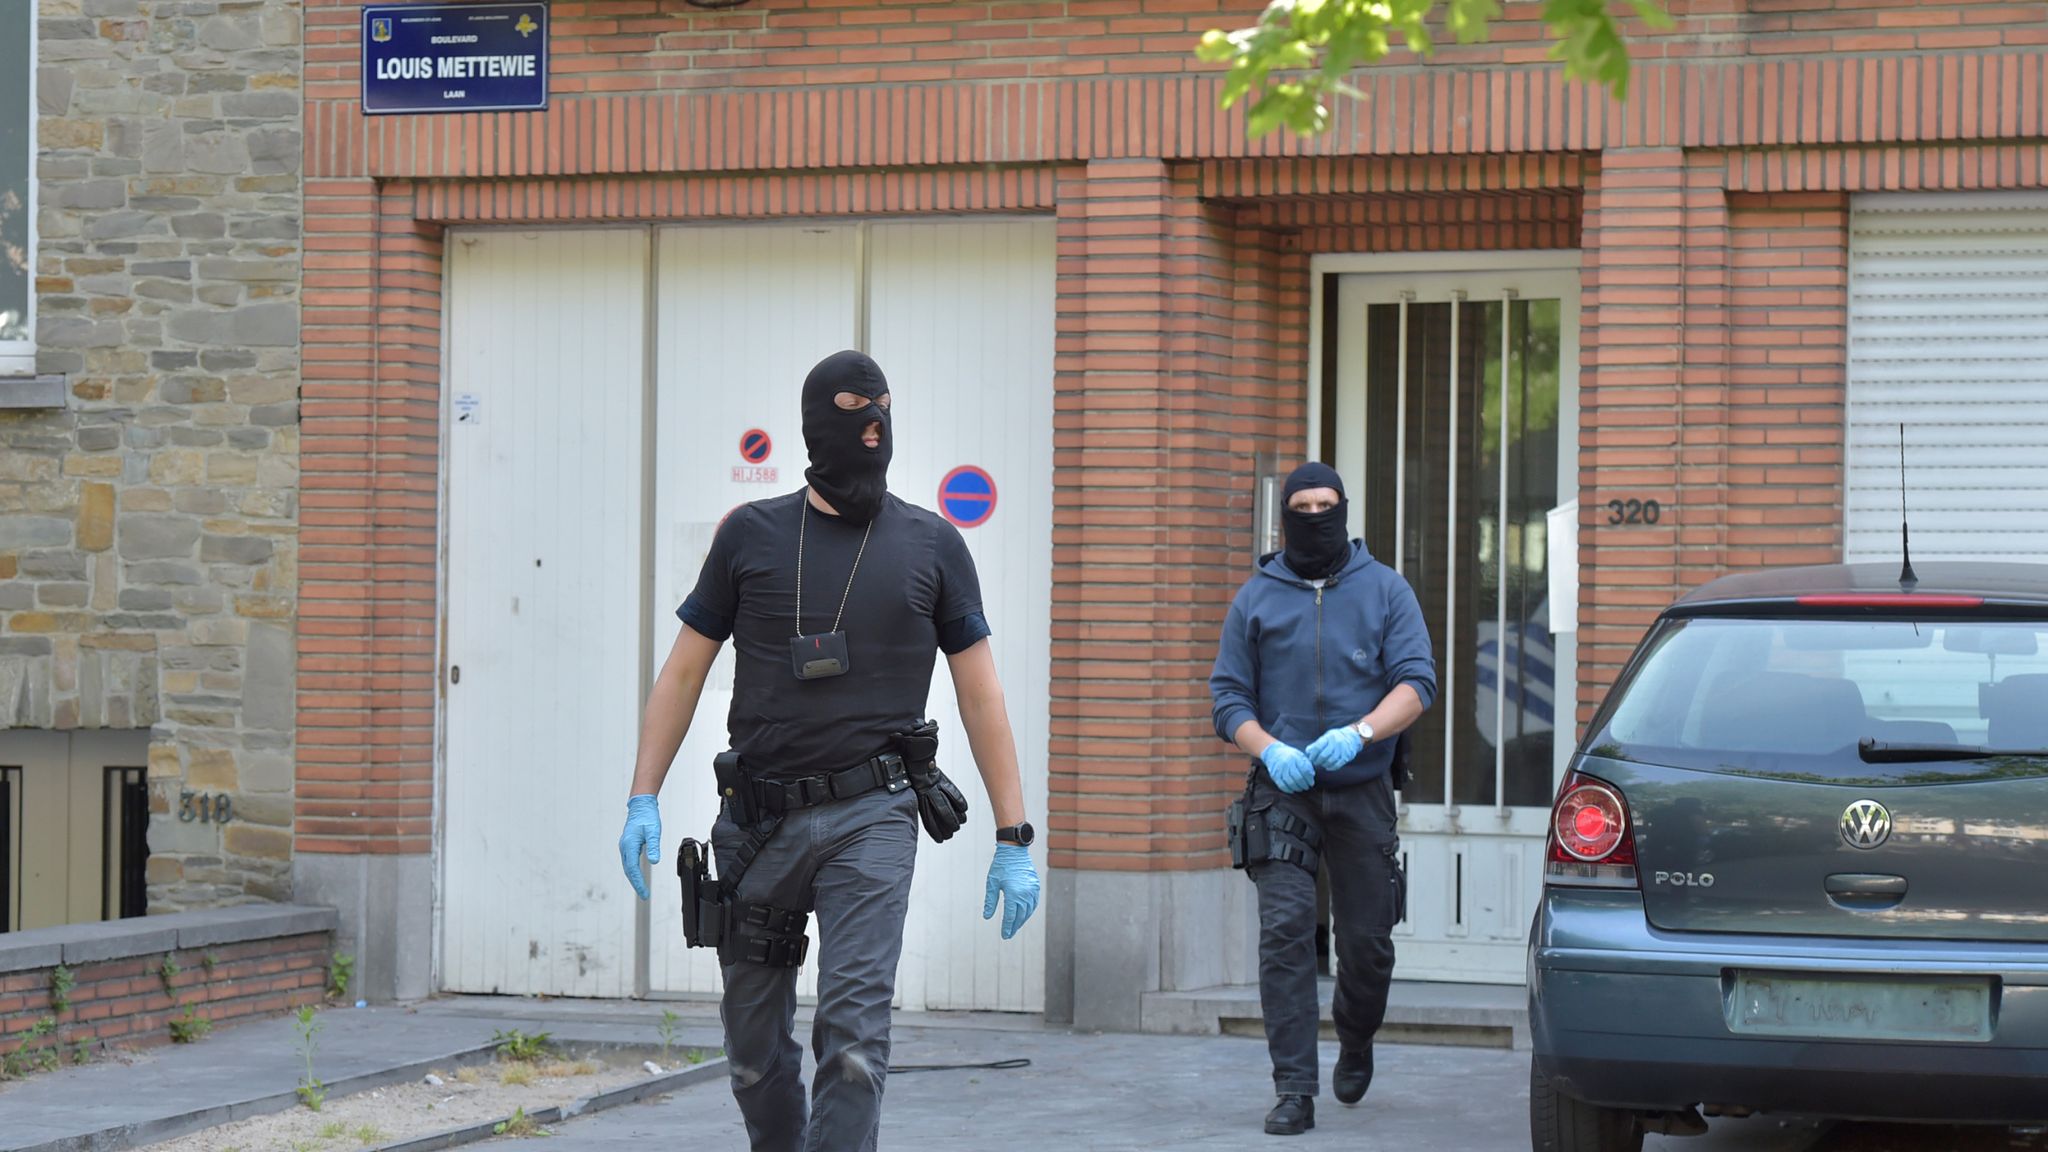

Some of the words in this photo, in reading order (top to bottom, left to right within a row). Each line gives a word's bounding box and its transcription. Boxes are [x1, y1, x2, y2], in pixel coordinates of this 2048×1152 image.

[431, 35, 478, 44] BOULEVARD
[377, 57, 433, 79] LOUIS
[437, 55, 536, 78] METTEWIE
[443, 90, 466, 99] LAAN
[1608, 499, 1660, 525] 320
[178, 792, 232, 823] 318
[1655, 871, 1715, 888] POLO
